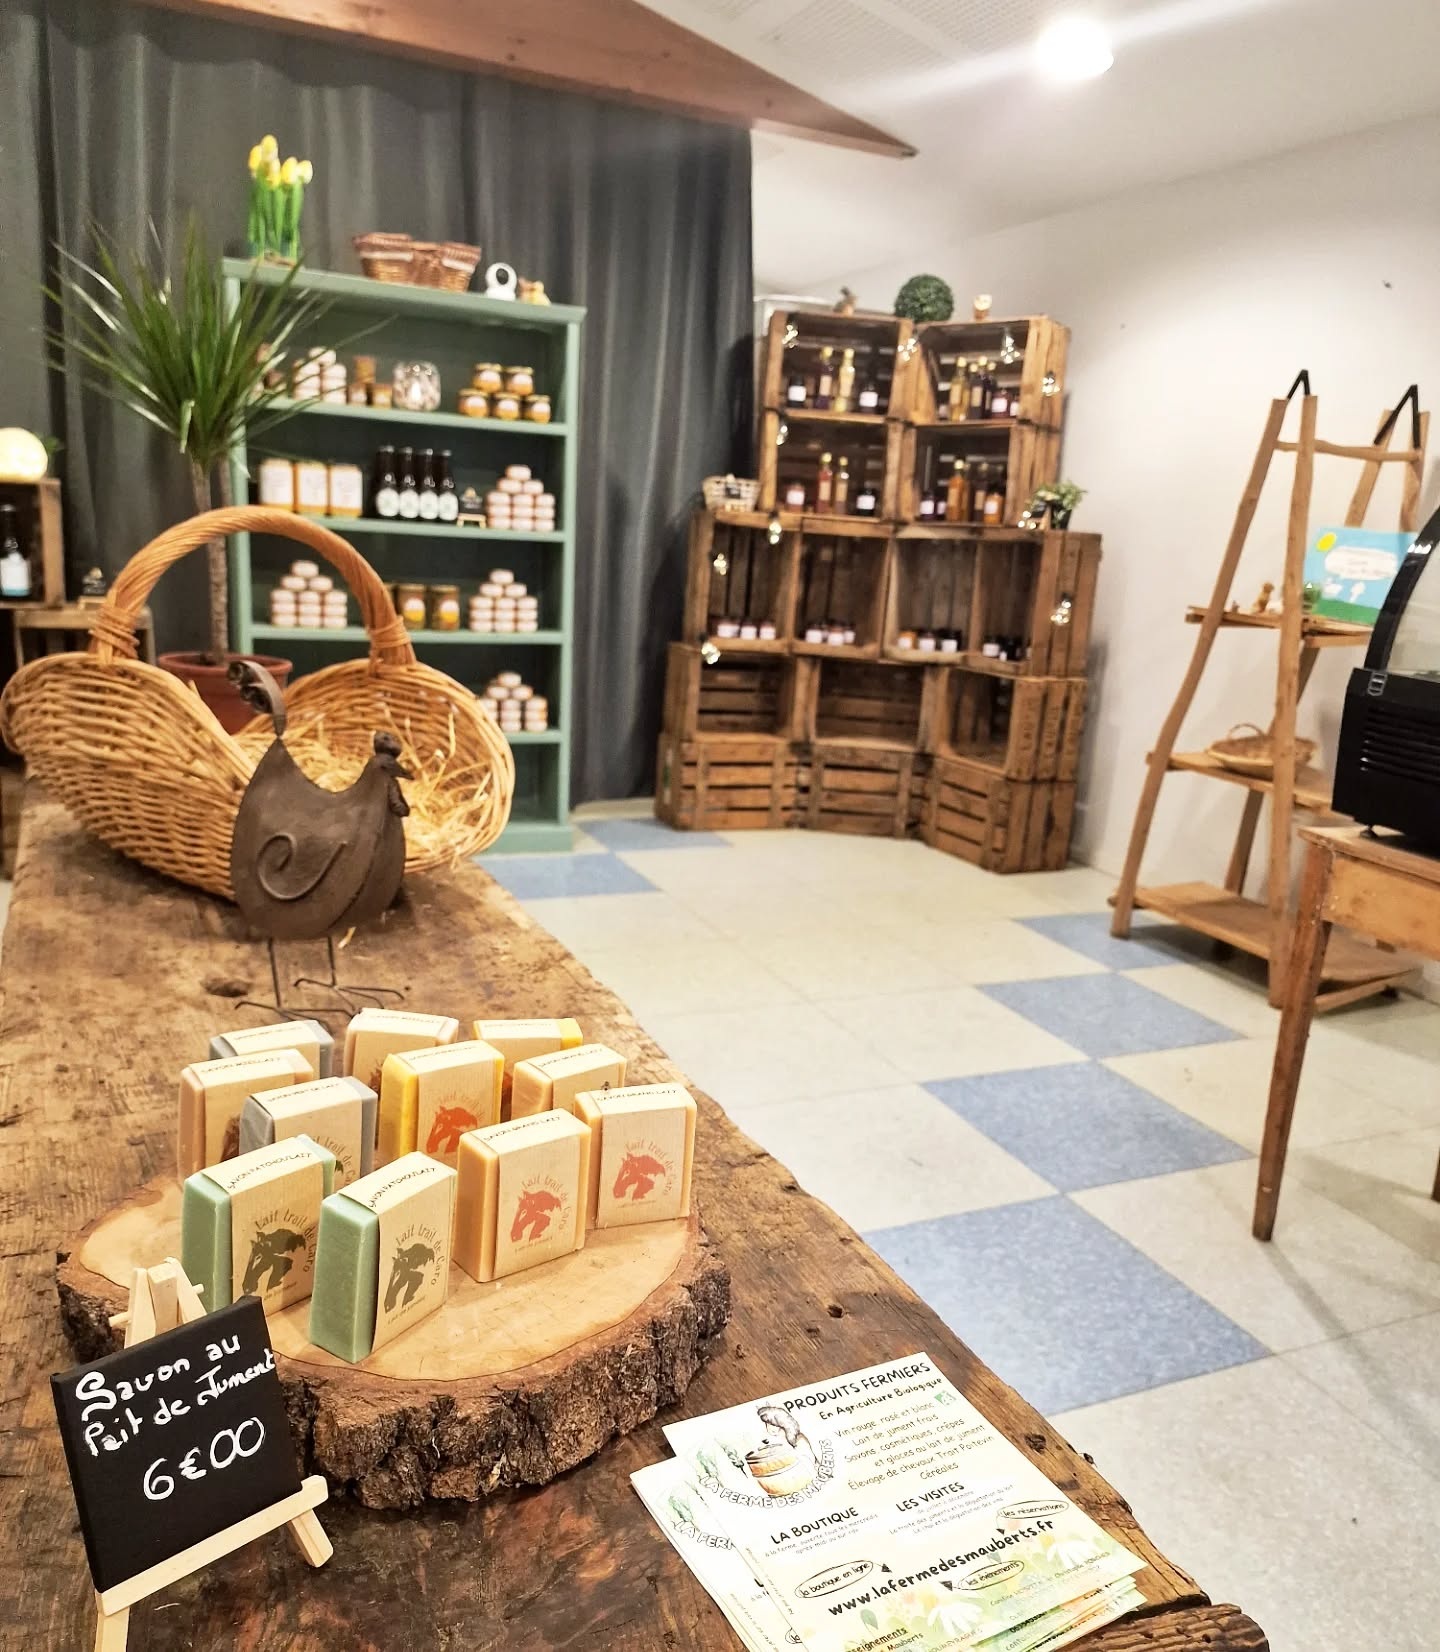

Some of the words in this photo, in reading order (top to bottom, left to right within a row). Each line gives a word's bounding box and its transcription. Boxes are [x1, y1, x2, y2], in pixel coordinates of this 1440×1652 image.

[75, 1357, 190, 1422] Savon
[205, 1333, 242, 1362] au
[783, 1383, 860, 1413] PRODUITS
[861, 1362, 930, 1390] FERMIERS
[818, 1411, 834, 1420] En
[836, 1393, 893, 1415] Agriculture
[893, 1378, 942, 1397] Biologique
[153, 1397, 191, 1426] de
[698, 1475, 720, 1494] LA
[720, 1487, 774, 1509] FERME
[776, 1491, 804, 1508] DES
[802, 1438, 835, 1499] MAUBERTS
[895, 1498, 920, 1512] LES
[918, 1482, 965, 1502] VISITES
[770, 1532, 791, 1545] LA
[791, 1507, 859, 1537] BOUTIQUE
[829, 1515, 1053, 1615] www.lafermedesmauberts.fr
